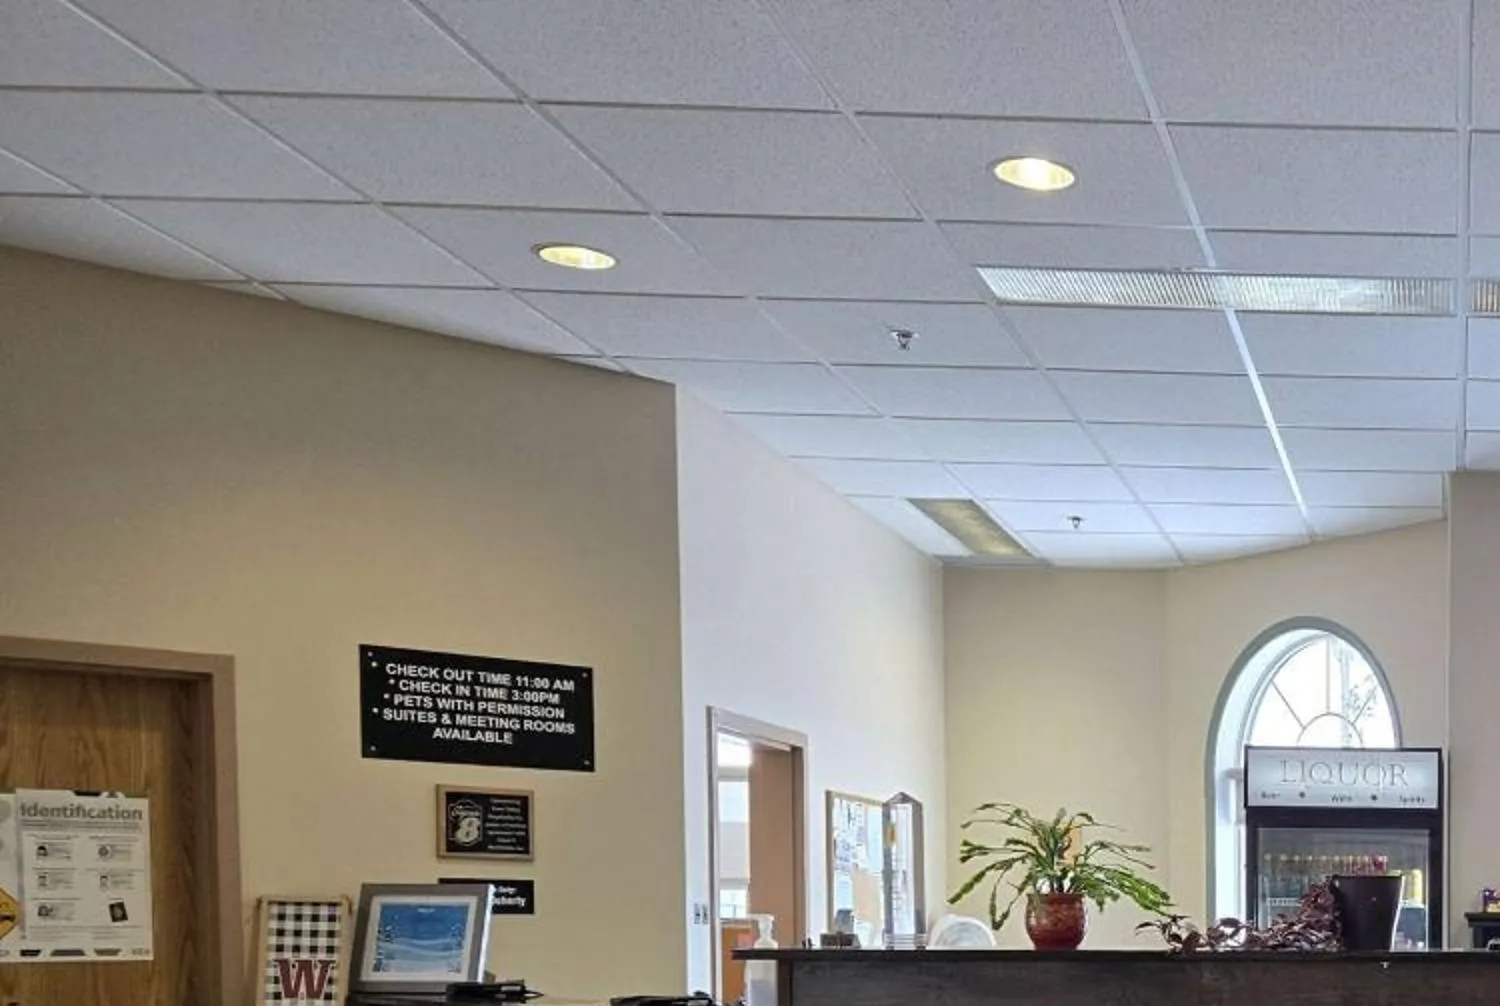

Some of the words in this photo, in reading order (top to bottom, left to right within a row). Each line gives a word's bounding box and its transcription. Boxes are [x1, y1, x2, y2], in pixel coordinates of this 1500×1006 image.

[385, 662, 441, 680] CHECK
[443, 667, 475, 683] OUT
[478, 671, 512, 687] TIME
[553, 678, 575, 692] AM
[399, 679, 452, 695] CHECK
[455, 683, 471, 697] IN
[474, 685, 508, 700] TIME
[511, 689, 560, 705] 3:00PM
[393, 694, 433, 709] PETS
[436, 698, 474, 712] WITH
[477, 701, 565, 719] PERMISSION
[382, 707, 437, 723] SUITES
[441, 712, 451, 725] &
[455, 713, 521, 730] MEETING
[523, 719, 575, 735] ROOMS
[432, 727, 513, 745] AVAILABLE
[1280, 759, 1409, 787] LIQUOR
[20, 802, 143, 821] Identification
